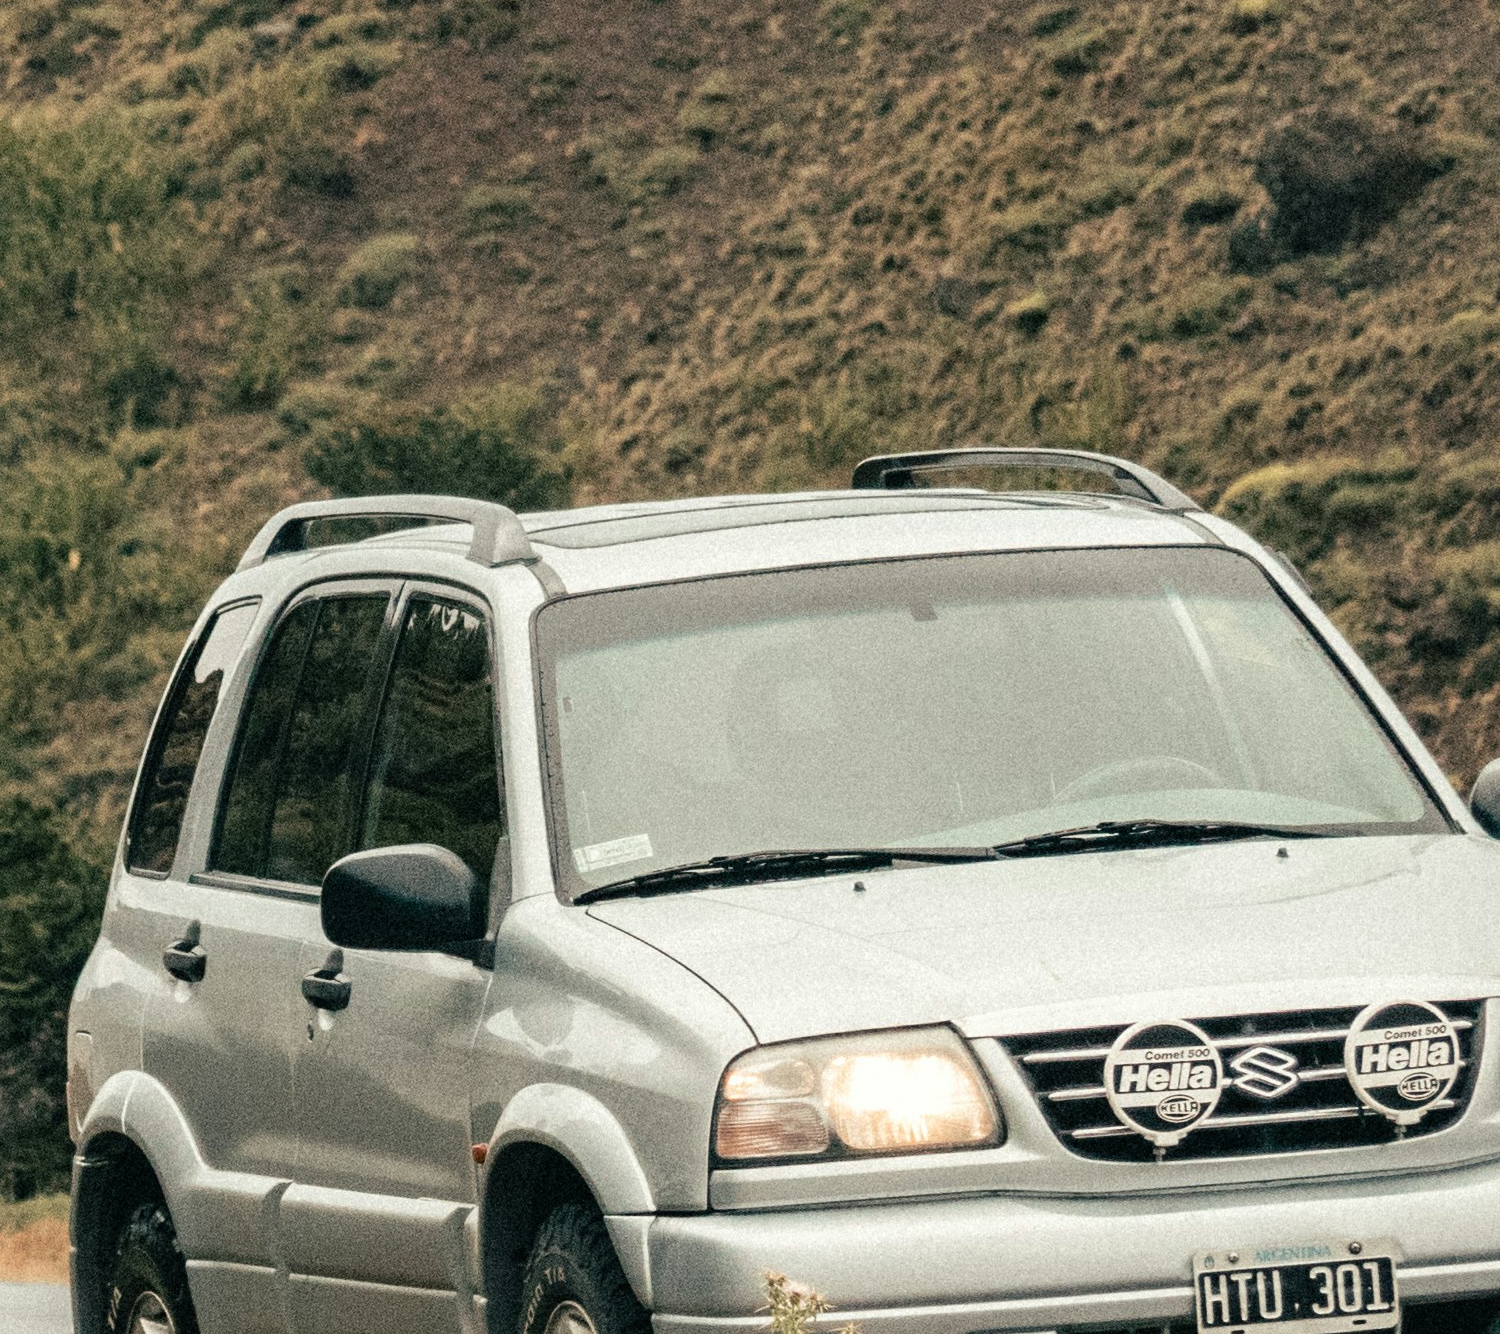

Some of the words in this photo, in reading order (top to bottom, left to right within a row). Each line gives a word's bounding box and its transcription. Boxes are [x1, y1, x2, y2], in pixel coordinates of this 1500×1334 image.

[1384, 1028, 1422, 1040] Comet
[1425, 1025, 1447, 1035] 500
[1144, 1050, 1184, 1061] Comet
[1188, 1048, 1211, 1058] 500
[1360, 1039, 1450, 1073] Hella
[1118, 1062, 1213, 1093] Hella
[1402, 1078, 1439, 1091] HELLA
[1161, 1101, 1199, 1113] HELLA
[1203, 1269, 1283, 1325] HTU
[1309, 1261, 1390, 1316] 301
